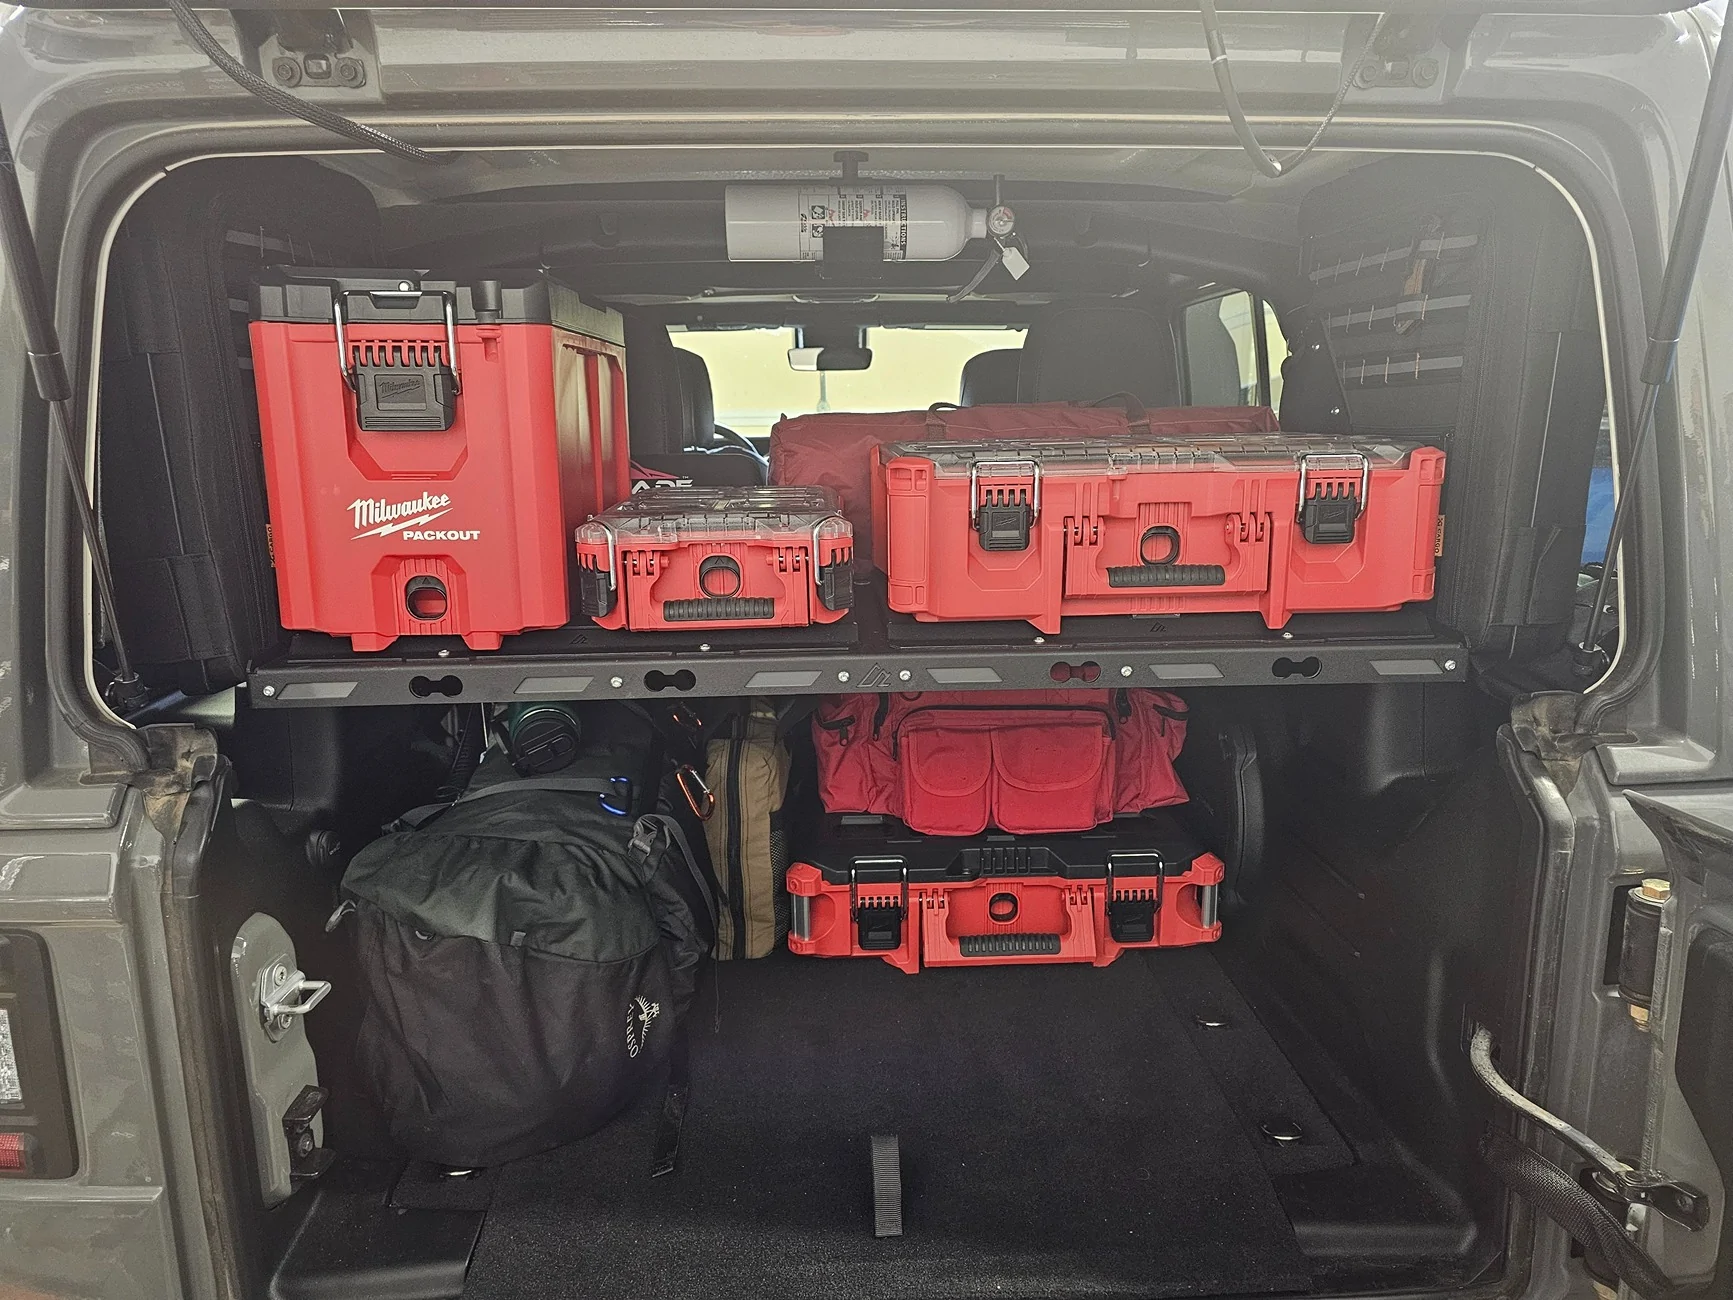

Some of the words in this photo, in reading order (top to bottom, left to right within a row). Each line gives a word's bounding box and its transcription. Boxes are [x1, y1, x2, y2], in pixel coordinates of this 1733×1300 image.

[346, 491, 452, 530] Milwaukee
[402, 530, 481, 541] PACKOUT
[1434, 528, 1442, 554] CARGO
[626, 1003, 639, 1058] OSPREY
